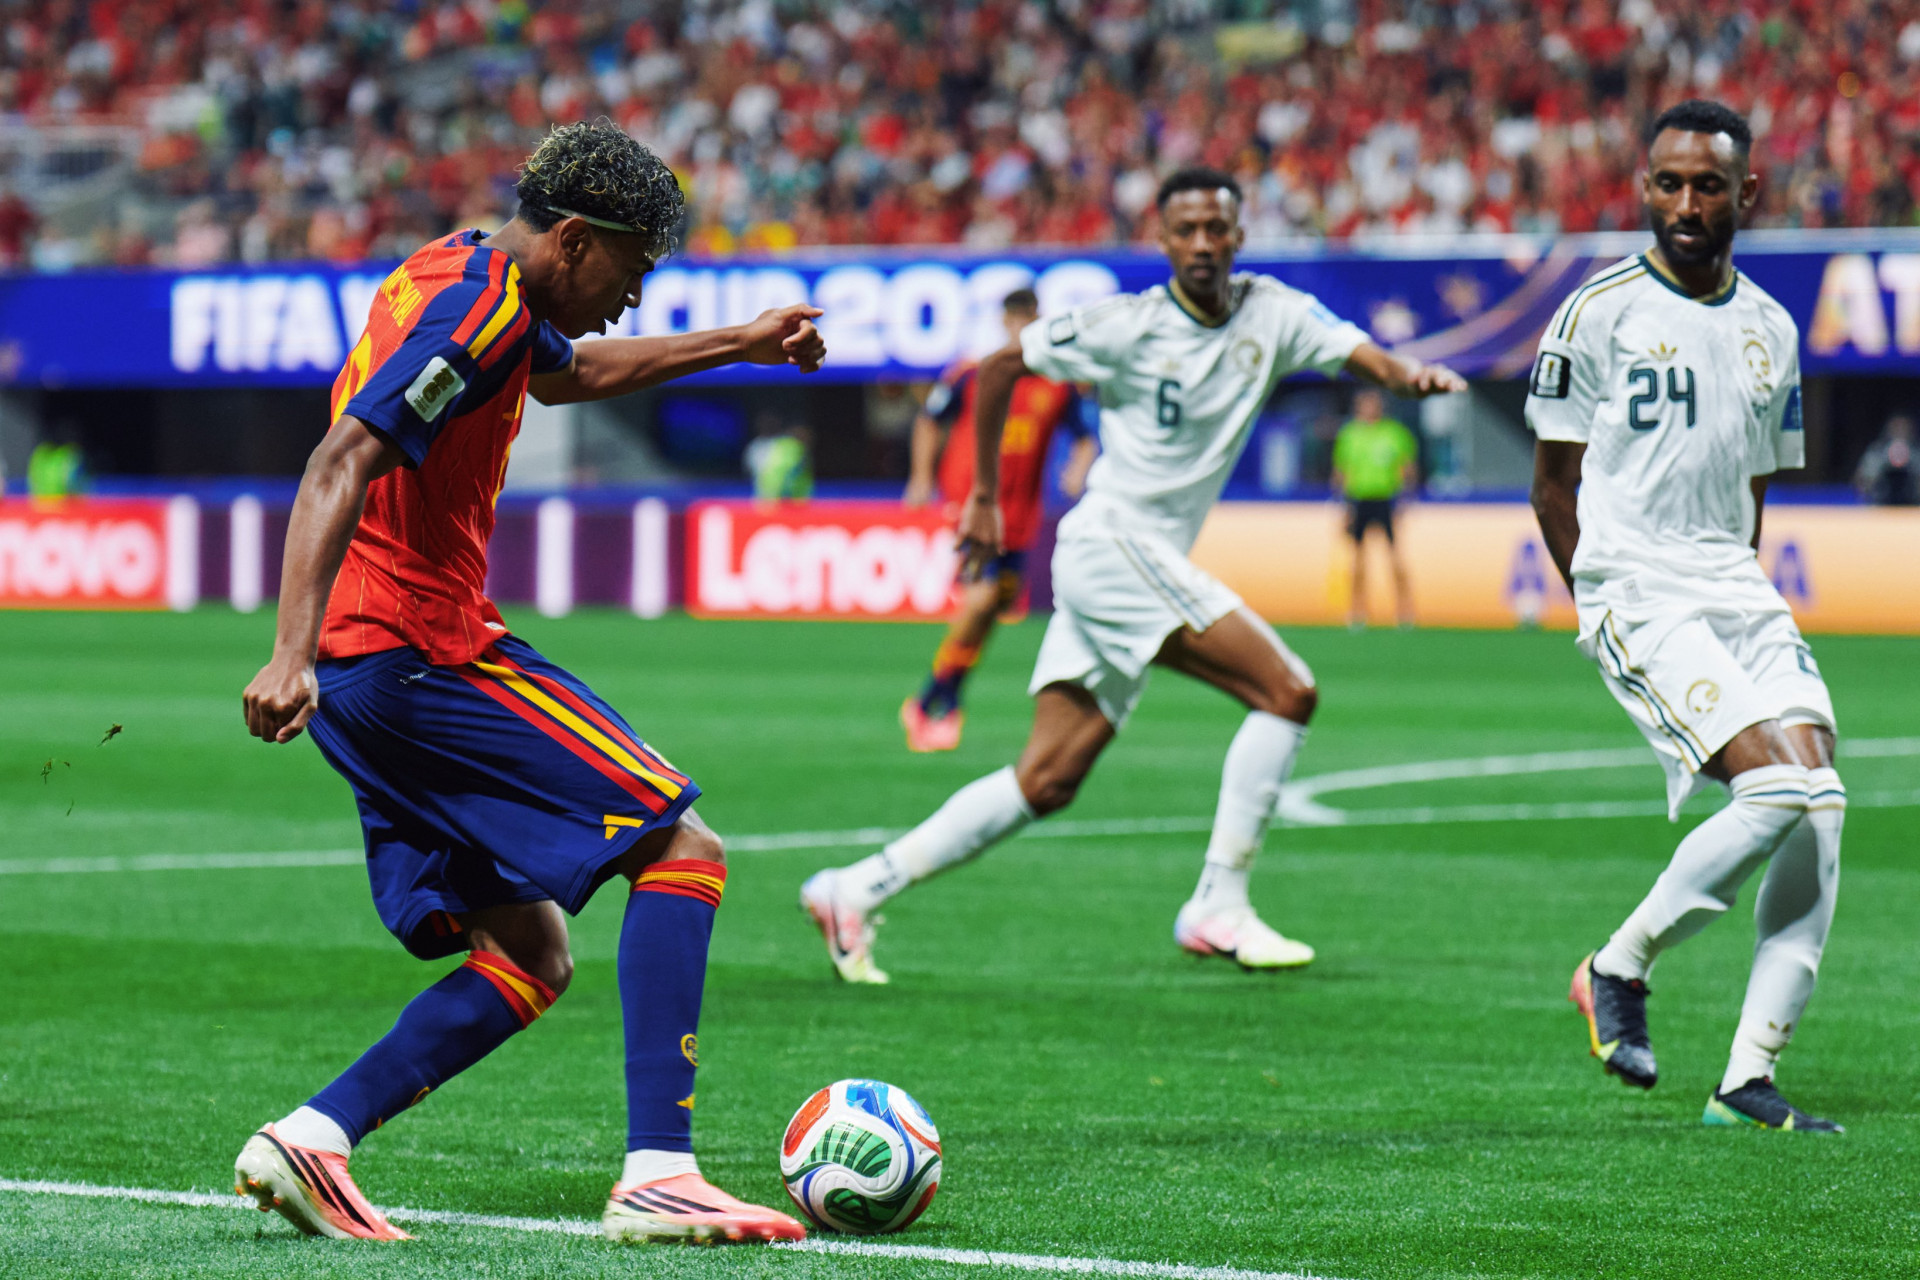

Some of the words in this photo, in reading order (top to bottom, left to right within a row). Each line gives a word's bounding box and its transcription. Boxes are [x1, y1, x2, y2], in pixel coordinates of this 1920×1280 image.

[171, 274, 342, 373] FIFA
[1806, 252, 1920, 356] AT
[1158, 378, 1183, 428] 6
[1628, 367, 1696, 430] 24
[700, 505, 960, 613] Lenov
